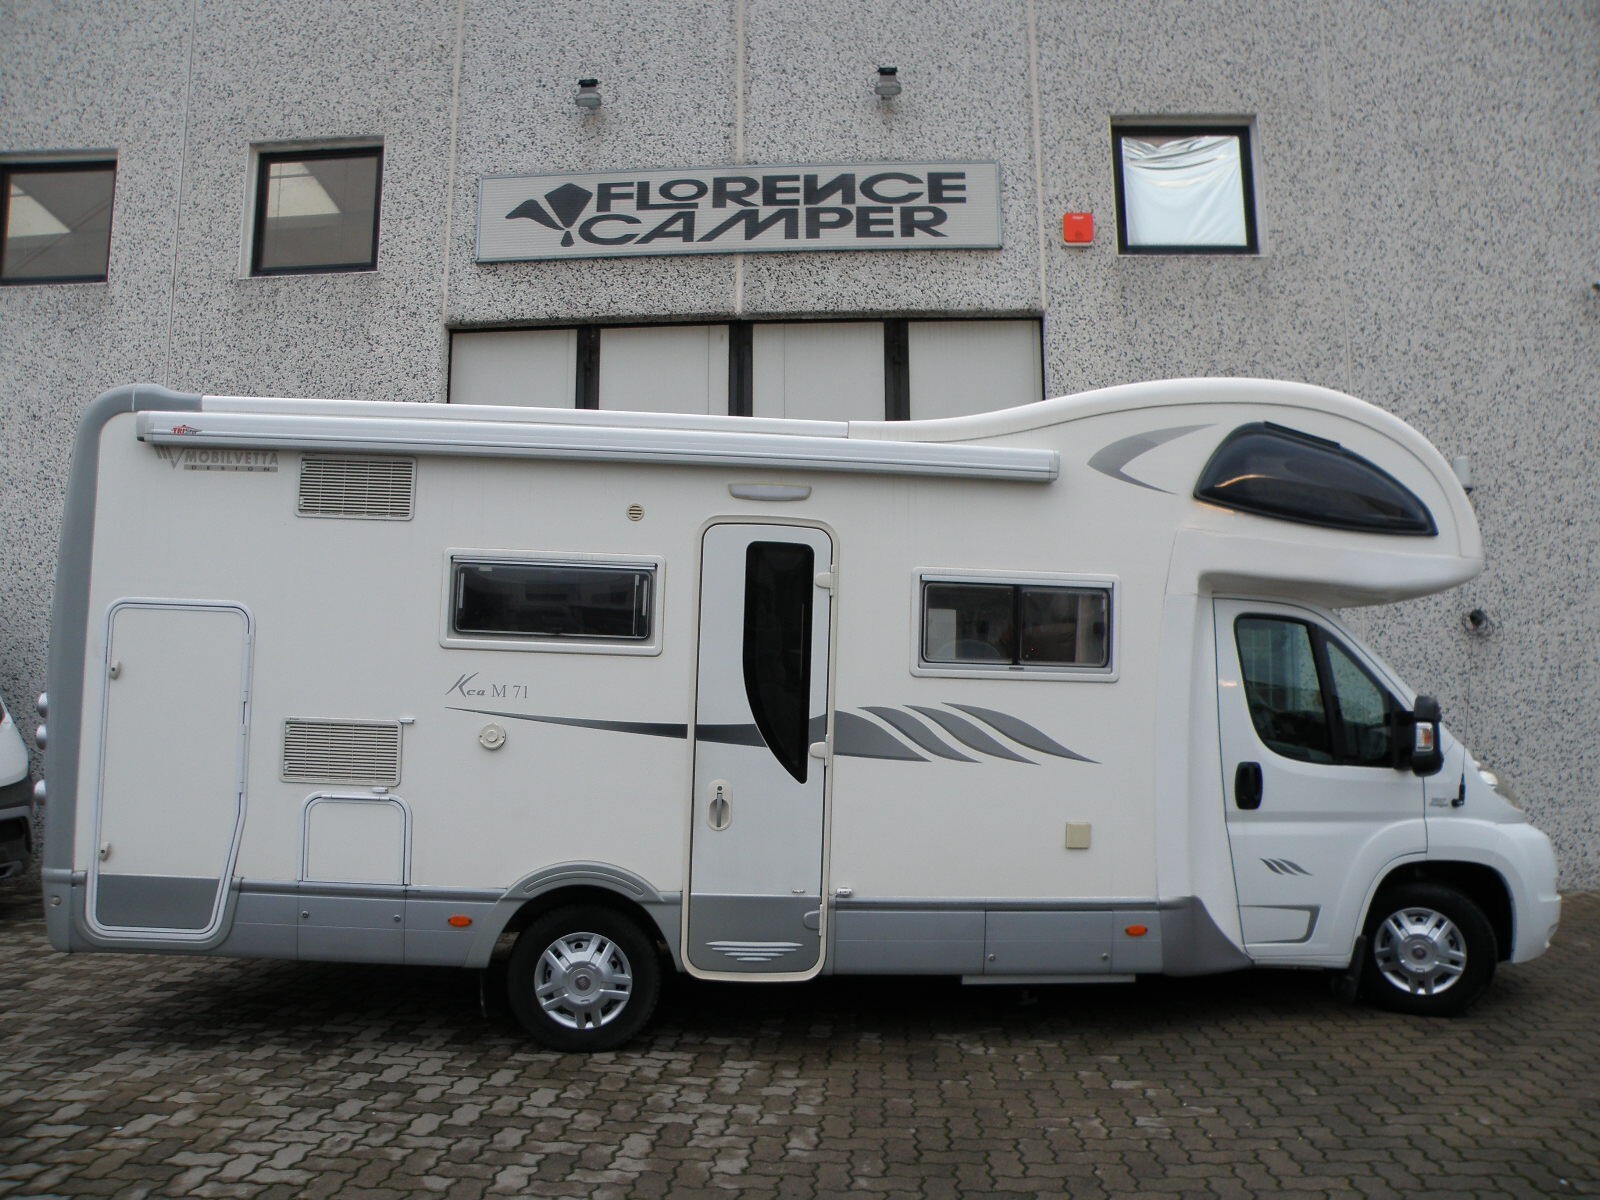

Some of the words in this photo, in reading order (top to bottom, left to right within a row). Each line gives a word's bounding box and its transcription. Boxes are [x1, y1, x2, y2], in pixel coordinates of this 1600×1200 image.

[596, 171, 967, 213] FLORENCE
[577, 205, 948, 246] CAMPER
[184, 449, 279, 465] MOBILVETTA
